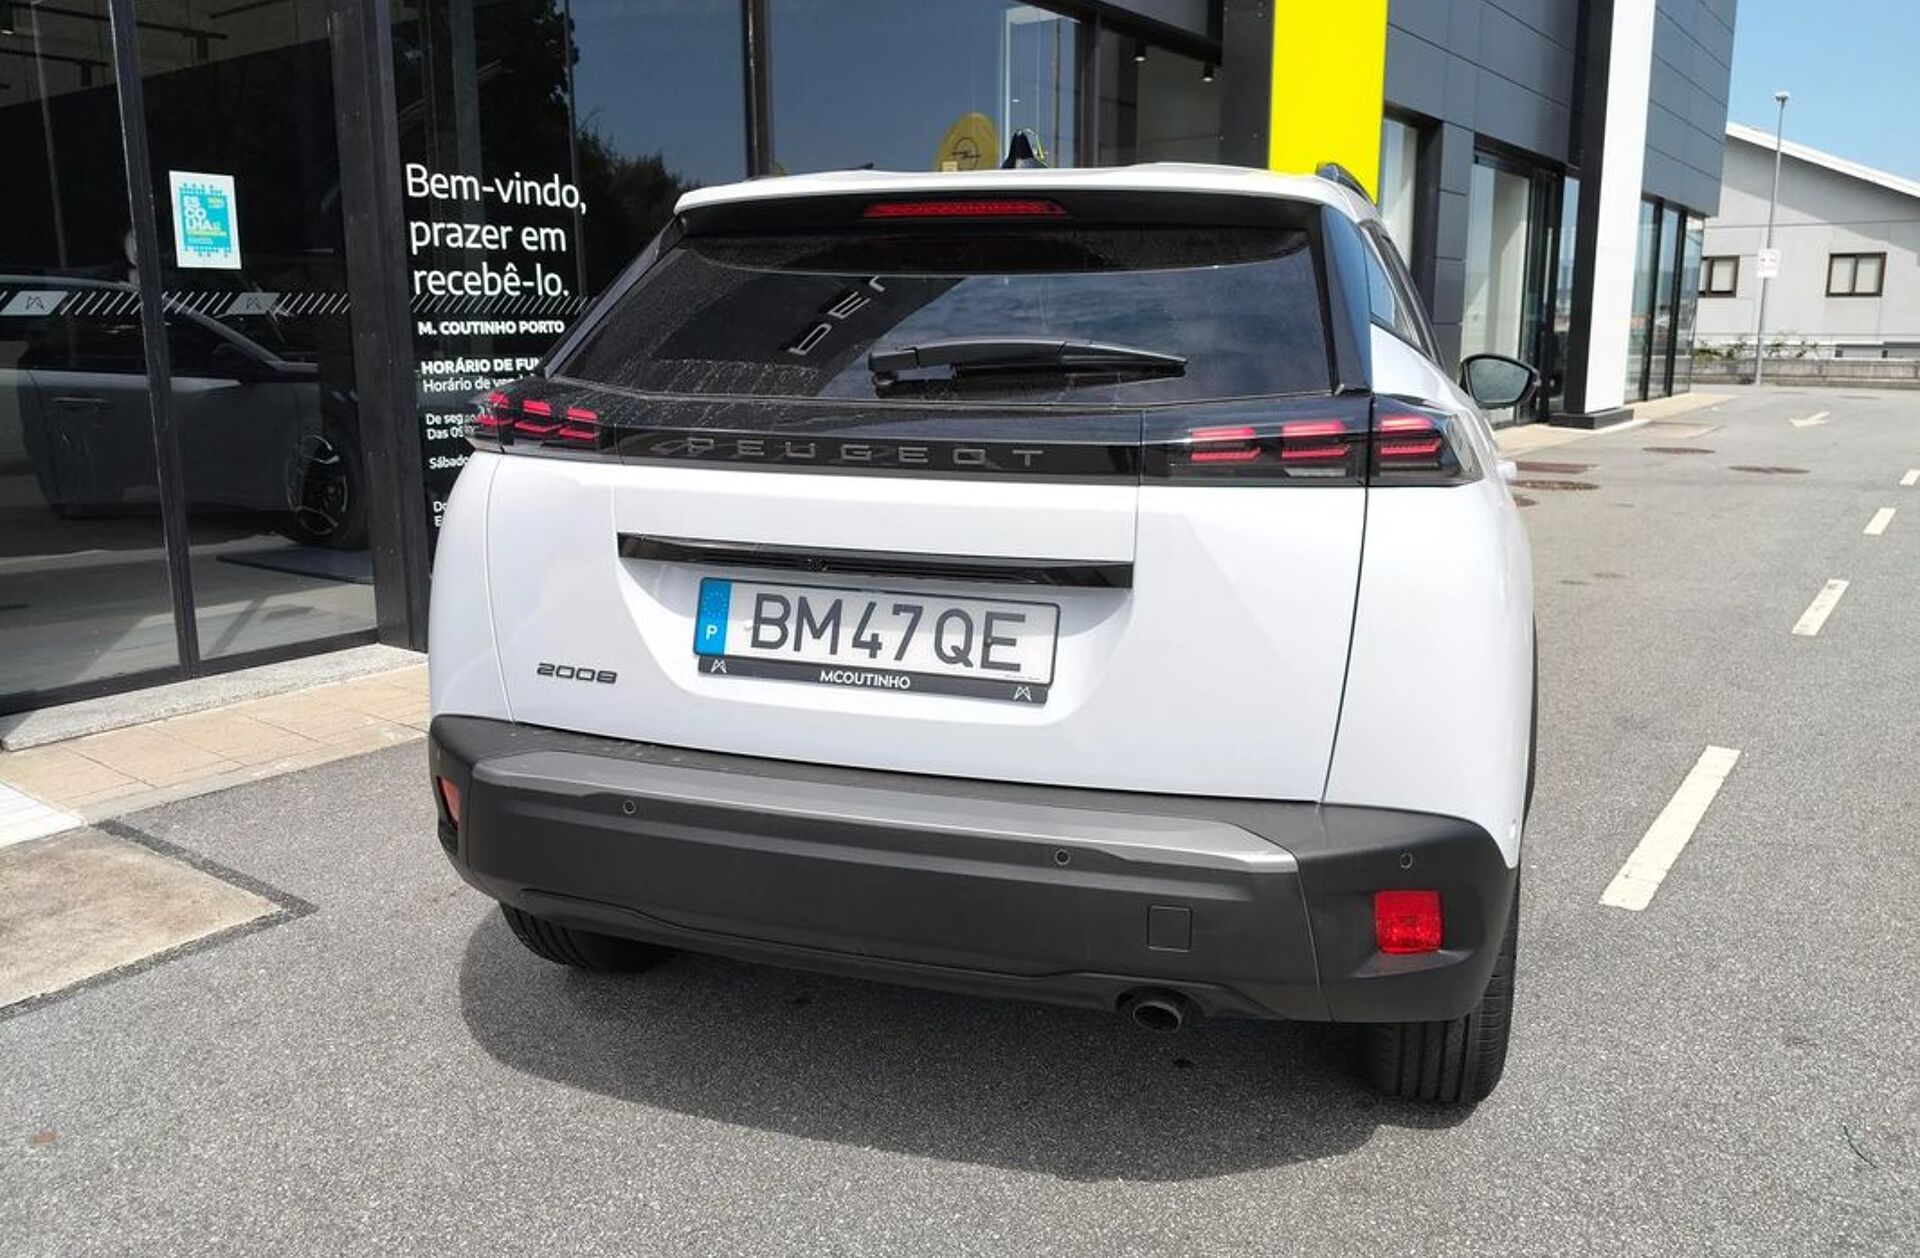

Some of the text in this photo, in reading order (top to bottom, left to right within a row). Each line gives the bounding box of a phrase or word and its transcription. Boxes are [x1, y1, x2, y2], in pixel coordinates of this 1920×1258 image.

[406, 163, 587, 215] Bem-vindo,
[410, 220, 566, 255] prazer em
[413, 262, 569, 297] recebê-lo.
[417, 320, 565, 336] M. COUTINHO PORTO
[421, 357, 490, 374] HORÁRIO
[493, 359, 513, 372] DE
[423, 377, 472, 393] Horário
[474, 376, 490, 389] de
[426, 413, 442, 425] De
[427, 428, 449, 440] Das
[687, 437, 1043, 468] PEUGEOT
[705, 624, 718, 641] P
[536, 662, 618, 684] 2008
[820, 670, 911, 690] MCOUTINHO
